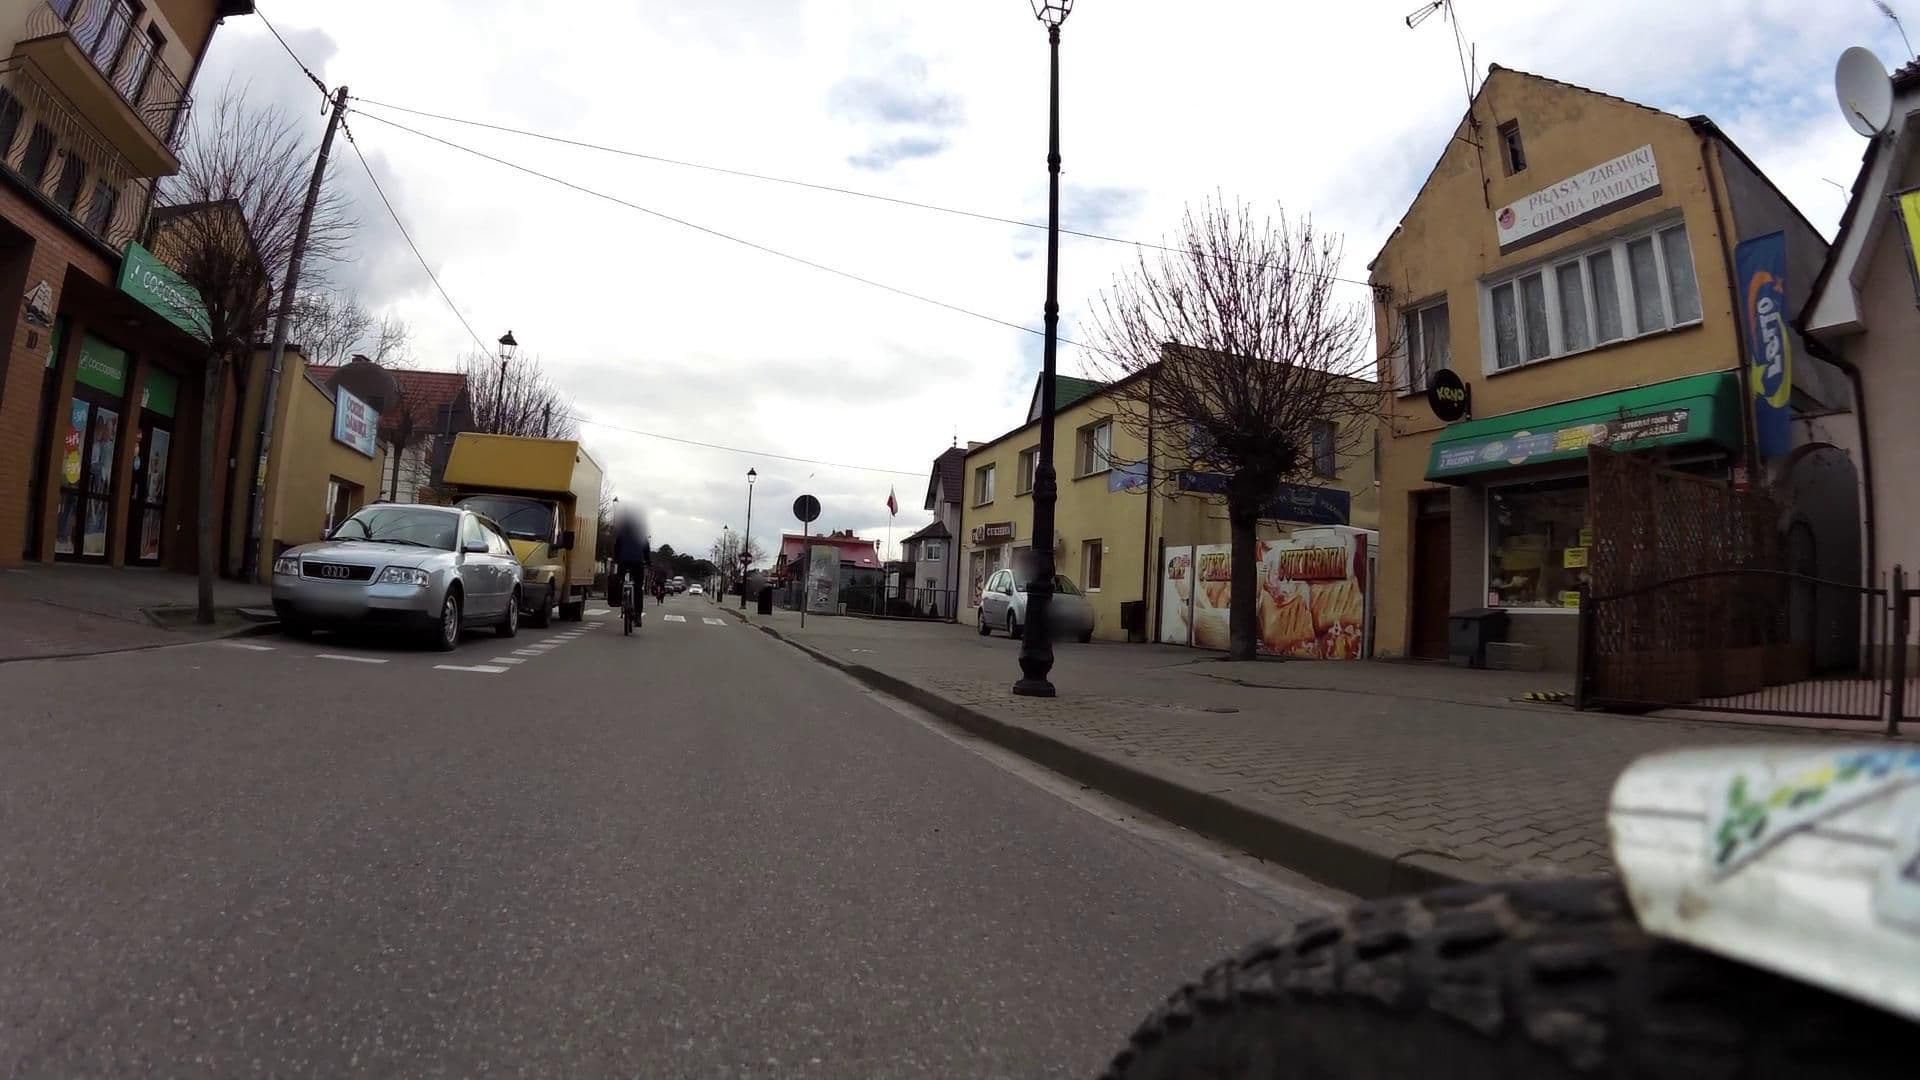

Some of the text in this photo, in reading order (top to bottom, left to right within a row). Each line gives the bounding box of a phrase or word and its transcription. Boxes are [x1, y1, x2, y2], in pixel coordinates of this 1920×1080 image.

[1529, 149, 1650, 211] PRASA ZABAWKI
[1532, 199, 1585, 228] CHEMIA
